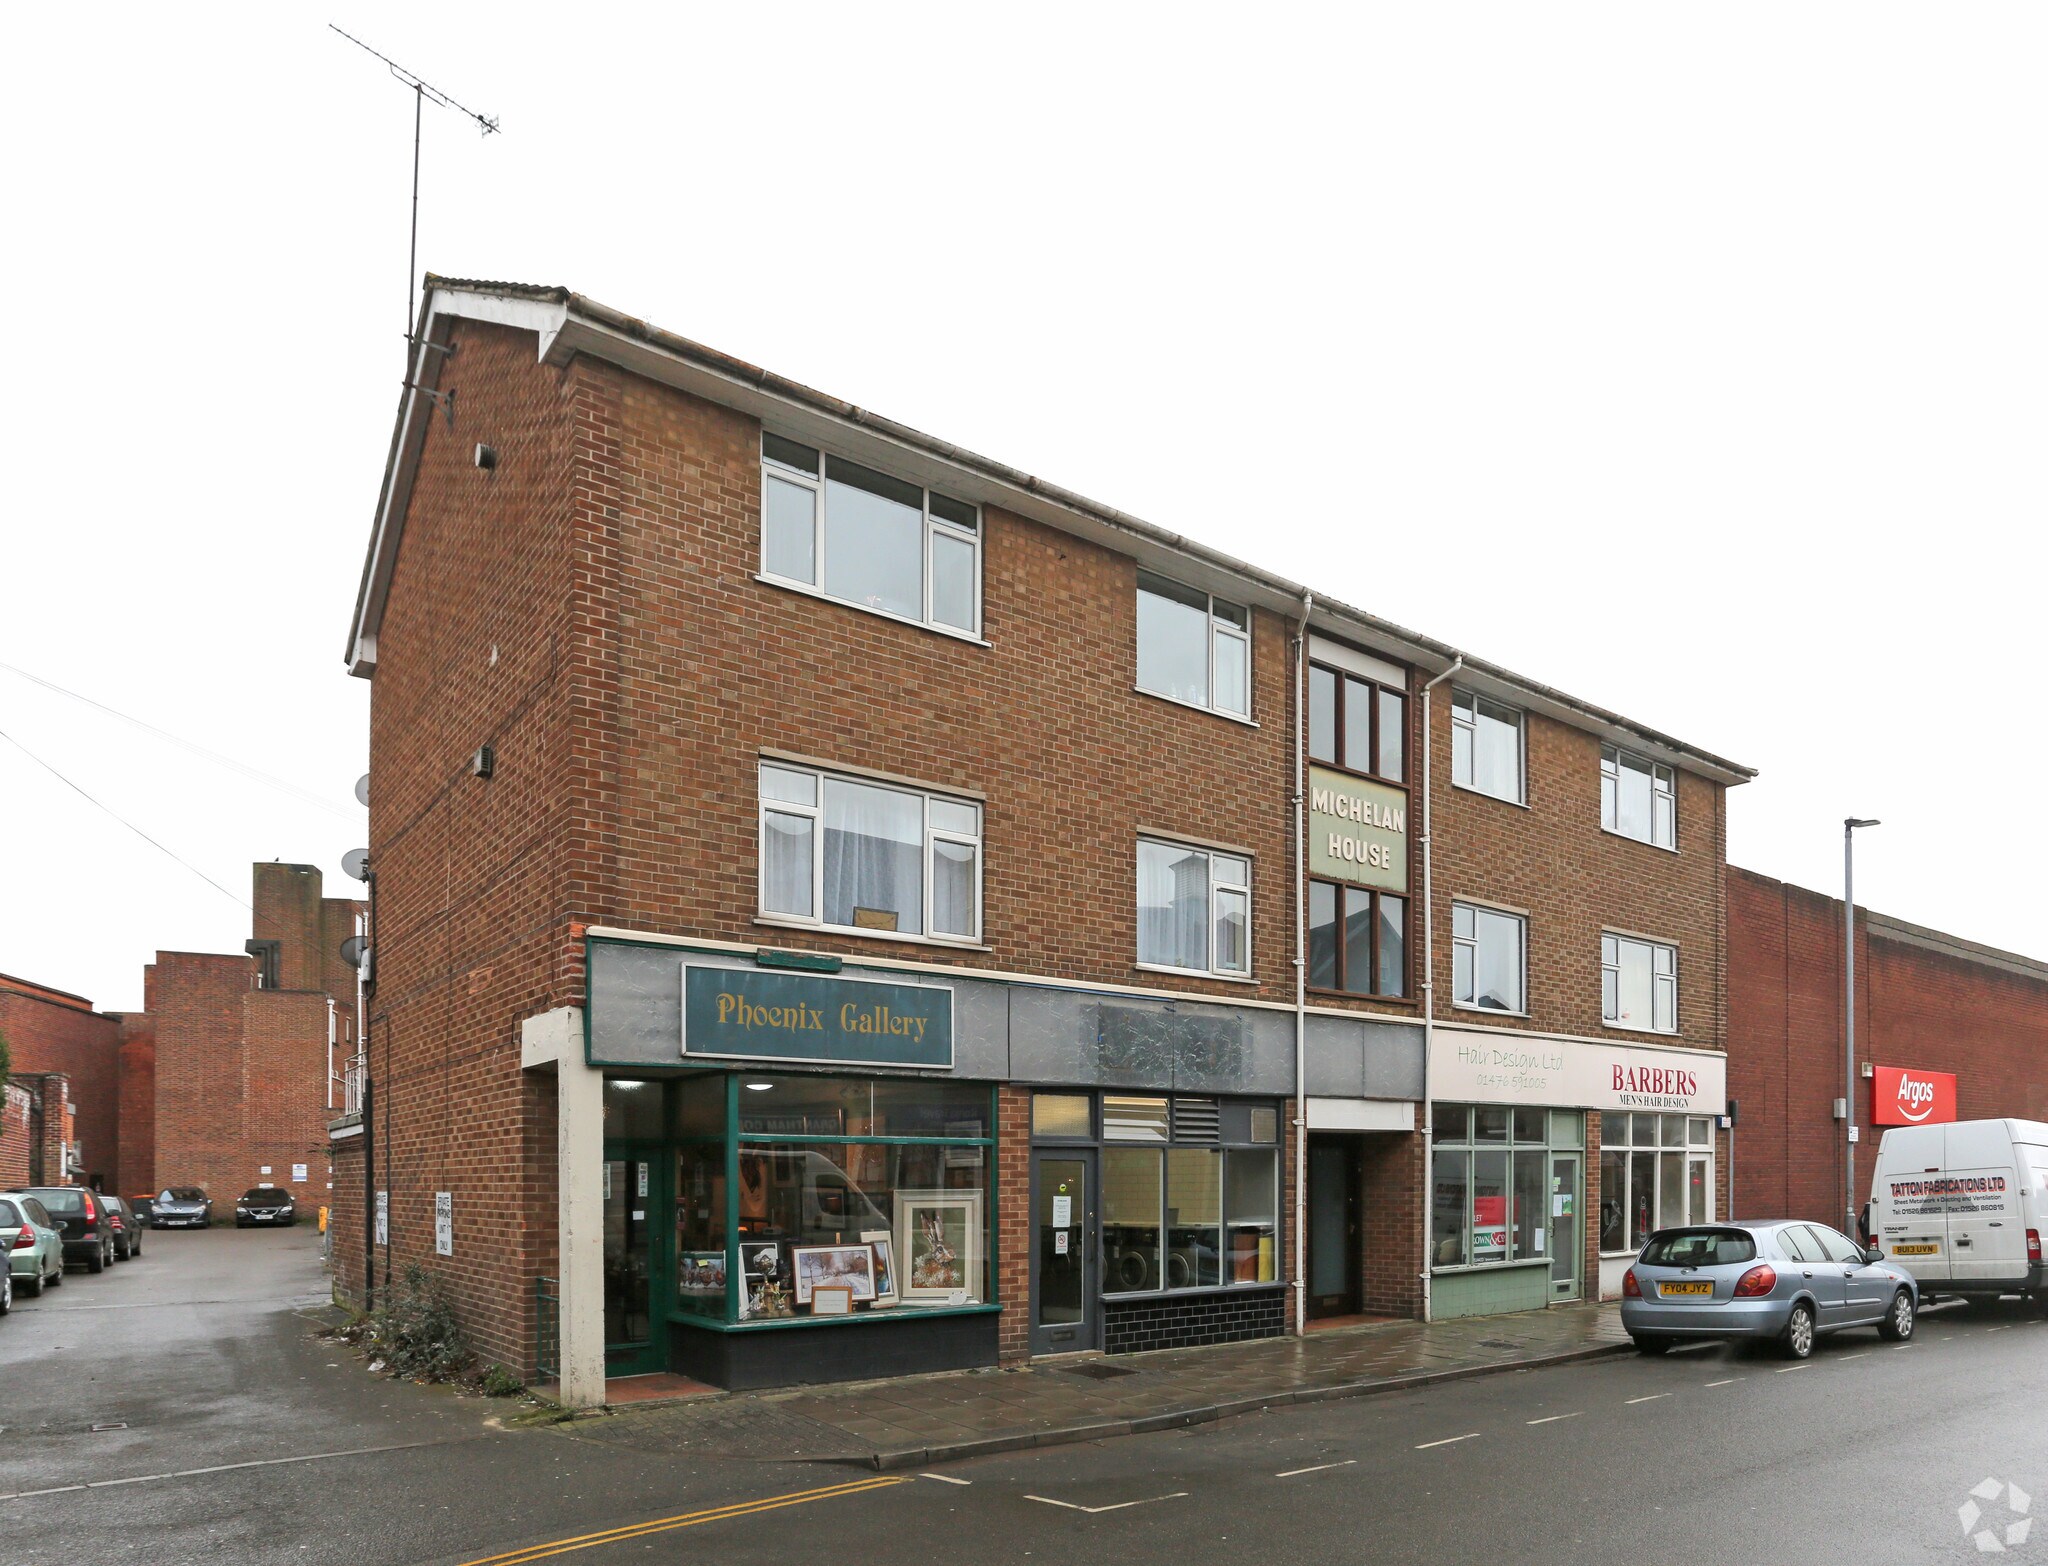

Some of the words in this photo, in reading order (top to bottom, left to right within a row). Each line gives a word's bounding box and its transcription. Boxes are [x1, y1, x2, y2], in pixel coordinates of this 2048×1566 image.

[1312, 787, 1404, 833] MICHELAN
[1328, 833, 1389, 869] HOUSE
[716, 993, 824, 1033] Phoenix
[840, 1003, 928, 1043] Gallery
[1458, 1045, 1489, 1064] Hair
[1493, 1048, 1538, 1075] Design
[1543, 1052, 1564, 1070] Ltd
[1477, 1074, 1509, 1089] 01476
[1512, 1076, 1547, 1093] 591005
[1611, 1064, 1697, 1096] BARBERS
[1898, 1073, 1934, 1109] Argos
[1619, 1094, 1643, 1106] MEN'S
[1644, 1096, 1661, 1107] HAIR
[1664, 1097, 1689, 1109] DESIGN
[1890, 1182, 1923, 1197] TATTON
[1924, 1177, 1987, 1196] FABRICATIONS
[1987, 1176, 2006, 1191] LTD
[1473, 1232, 1505, 1246] OWN&Co
[1897, 1245, 1914, 1253] BU13
[1916, 1244, 1933, 1252] UVN
[1664, 1284, 1687, 1293] FY04
[1690, 1284, 1708, 1293] JYZ
